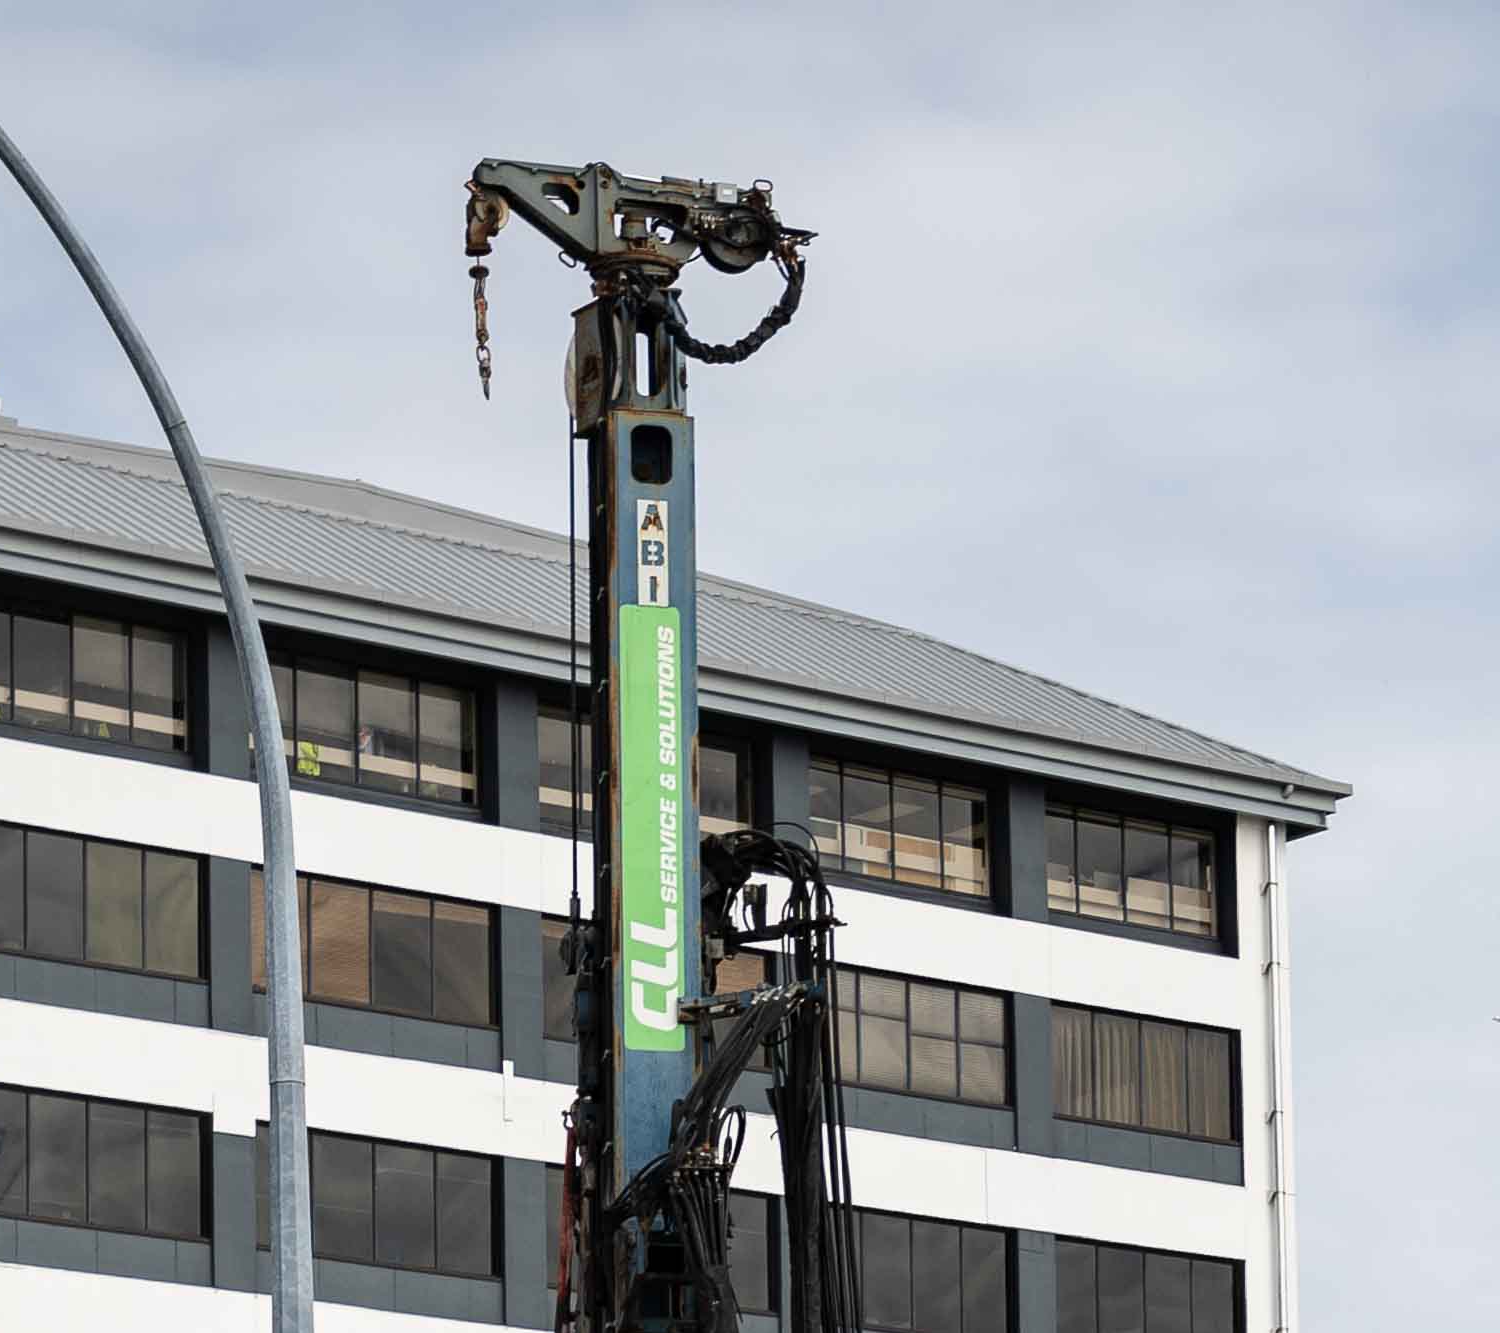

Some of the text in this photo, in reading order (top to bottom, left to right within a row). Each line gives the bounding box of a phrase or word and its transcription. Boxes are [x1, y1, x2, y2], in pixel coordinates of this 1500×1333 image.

[641, 504, 664, 602] ABI
[630, 625, 679, 1031] CLL SERVICE & SOLUTIONS
